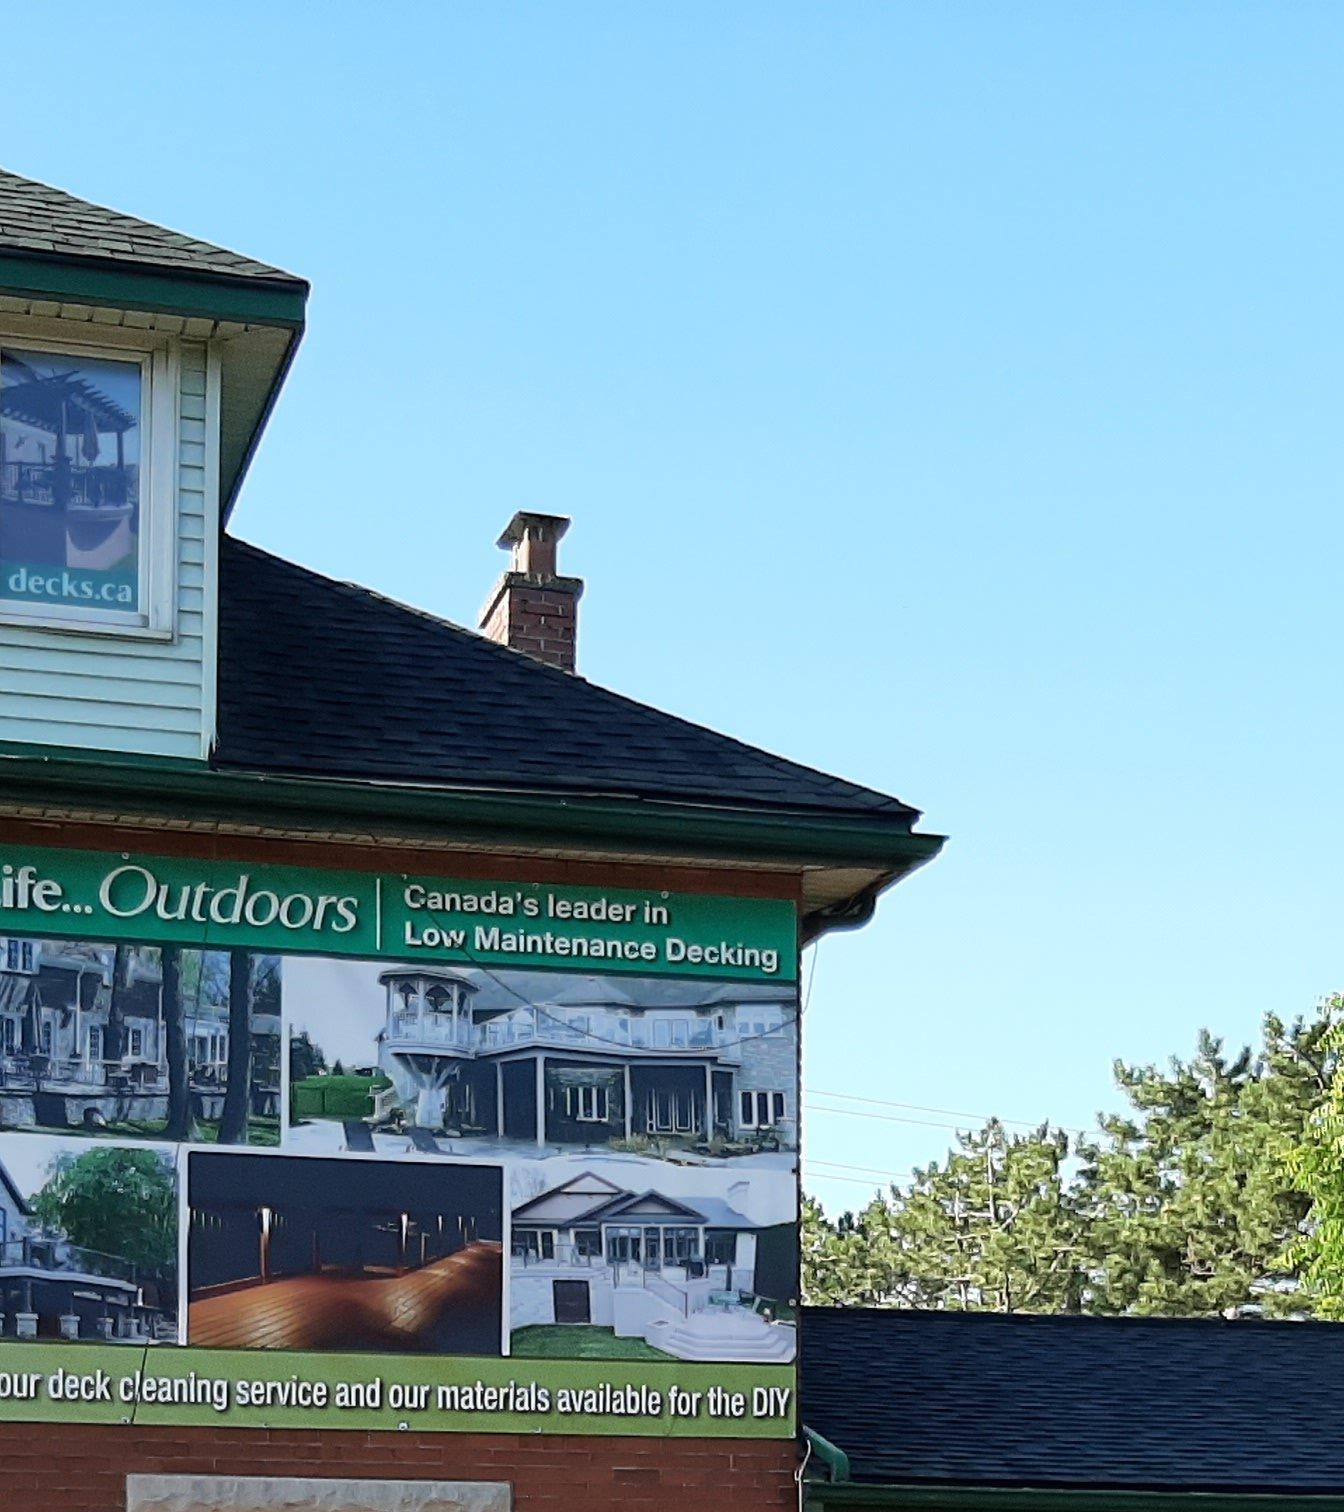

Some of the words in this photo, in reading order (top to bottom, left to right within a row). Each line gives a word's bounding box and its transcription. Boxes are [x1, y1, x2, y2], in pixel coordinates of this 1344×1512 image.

[8, 568, 133, 602] decks.ca
[99, 865, 358, 932] Outdoors
[404, 884, 539, 917] Canada's
[548, 893, 636, 923] leader
[644, 901, 668, 925] in
[404, 921, 465, 948] Low
[474, 925, 657, 960] Maintenance
[666, 938, 778, 972] Decking
[48, 1367, 111, 1401] deck
[120, 1370, 227, 1411] cleaning
[236, 1375, 327, 1407] service
[336, 1377, 382, 1409] and
[389, 1383, 430, 1409] our
[438, 1380, 550, 1413] materials
[557, 1384, 661, 1416] available
[669, 1385, 701, 1417] for
[707, 1387, 745, 1417] the
[753, 1387, 790, 1418] DIY
